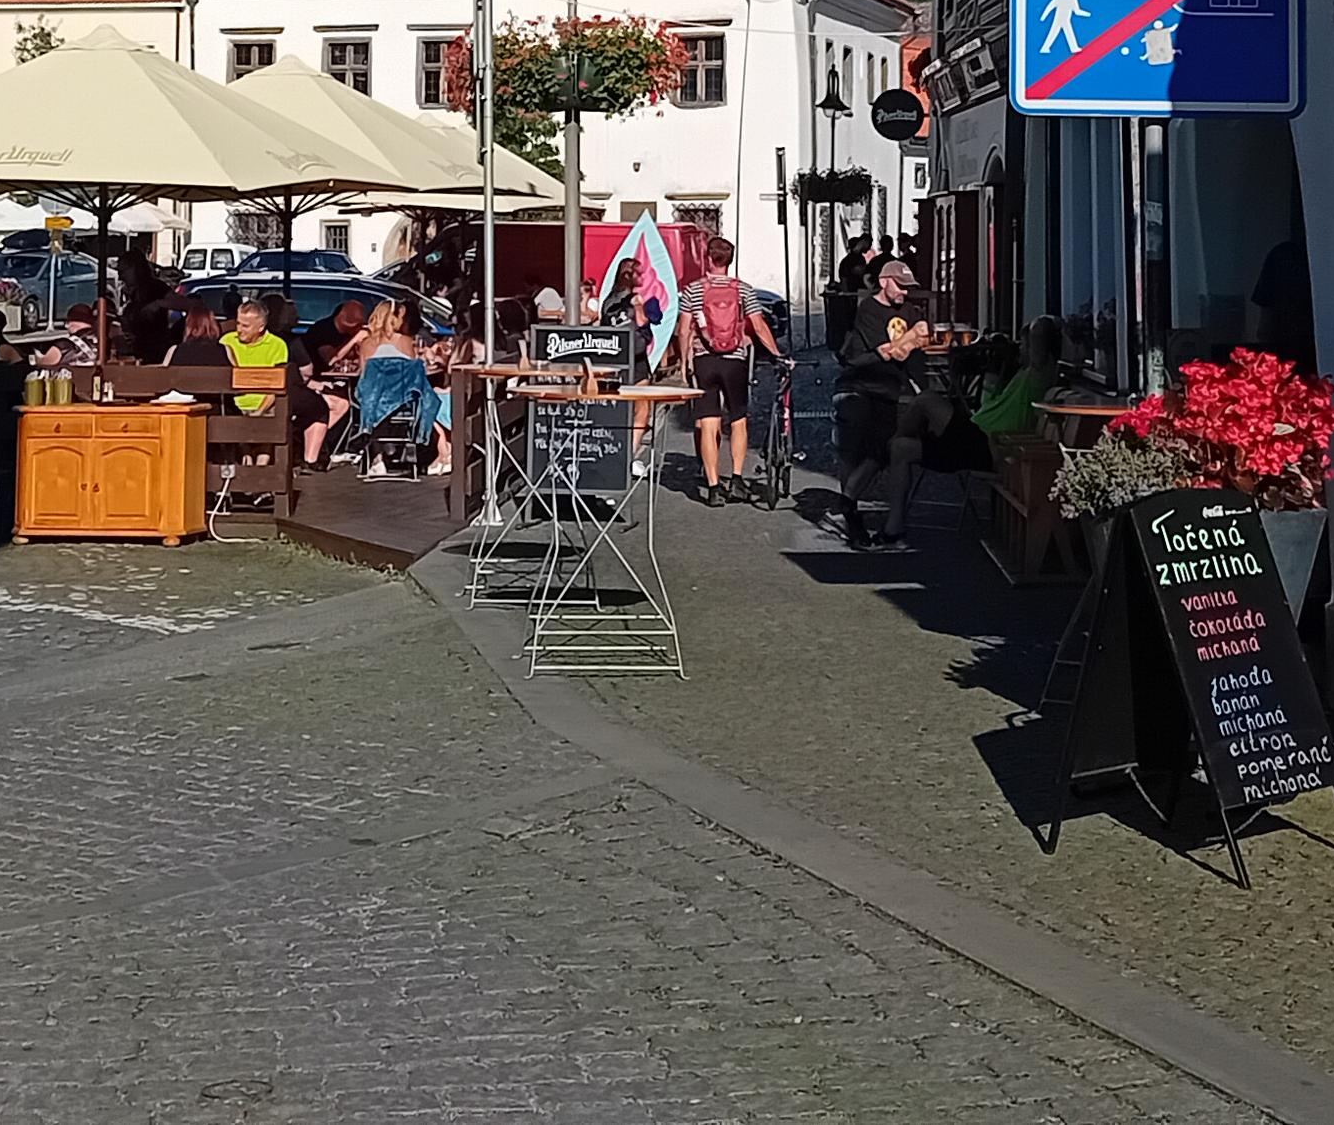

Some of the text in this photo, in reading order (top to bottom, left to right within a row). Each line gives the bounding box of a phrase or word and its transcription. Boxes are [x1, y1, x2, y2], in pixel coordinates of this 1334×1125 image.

[6, 145, 73, 167] Urquell
[547, 333, 584, 359] Pilsner
[1151, 509, 1245, 552] Točená
[1155, 553, 1263, 586] zmrzlina
[1181, 590, 1238, 612] vanilka
[1189, 609, 1267, 638] čokoláda
[1211, 665, 1273, 697] jahoda
[1212, 690, 1260, 715] banán
[1229, 730, 1297, 756] citron
[1237, 735, 1332, 780] pomeranč
[1243, 765, 1322, 803] míchaná
